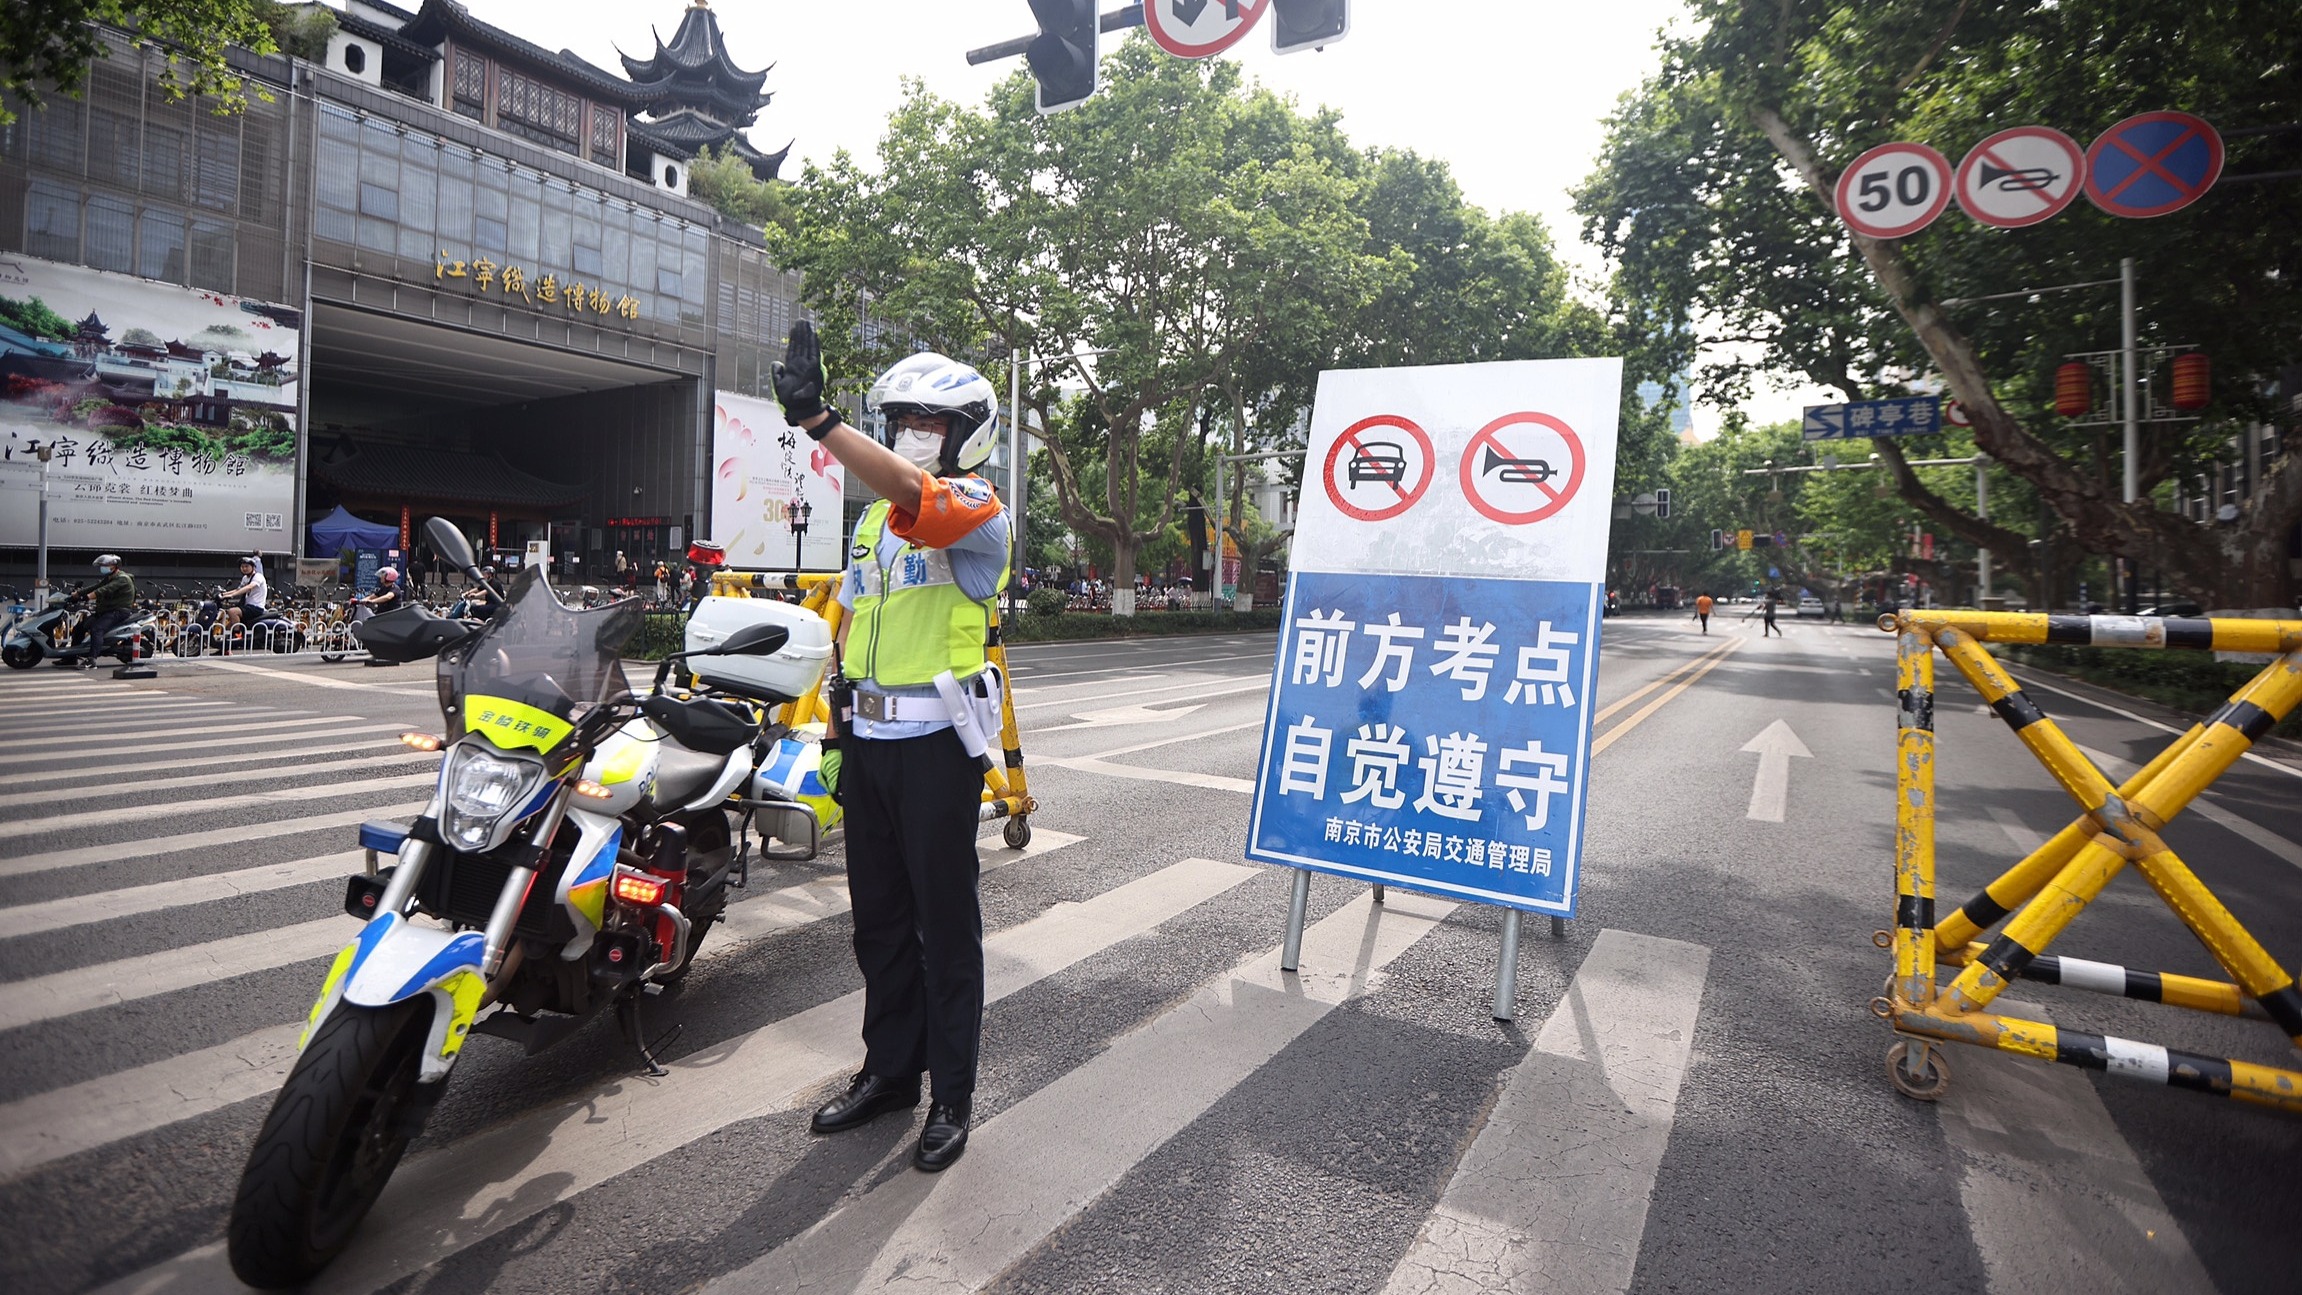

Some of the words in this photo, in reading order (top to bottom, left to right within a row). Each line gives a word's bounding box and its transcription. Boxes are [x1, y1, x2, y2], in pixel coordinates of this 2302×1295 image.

[1858, 164, 1930, 213] 50
[1850, 401, 1934, 428] 碑亭巷
[1292, 607, 1579, 709] 前方考点
[477, 710, 551, 739] 金陵铁骑
[1278, 714, 1569, 831] 自觉遵守
[1324, 815, 1552, 878] 南京市公安局交通管理局
